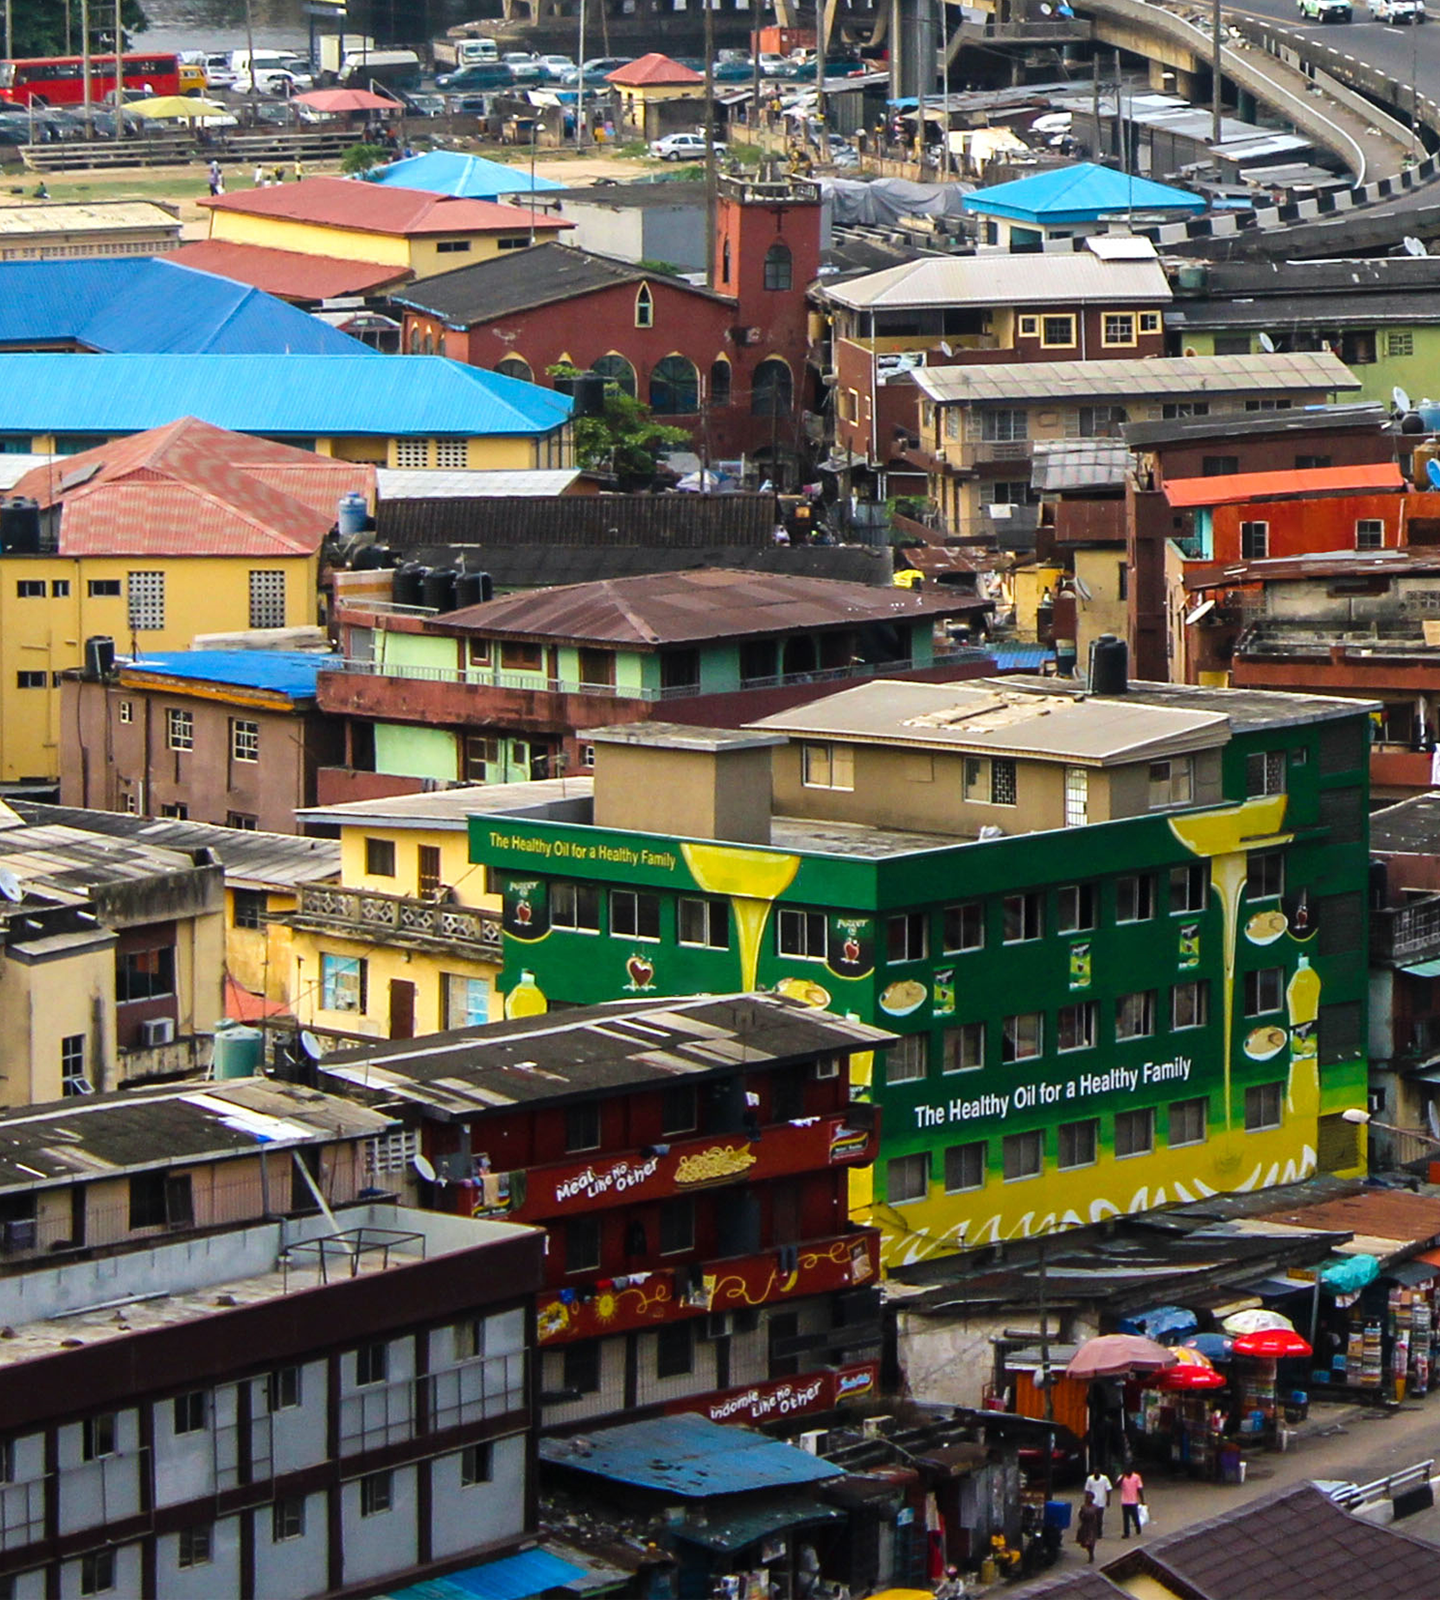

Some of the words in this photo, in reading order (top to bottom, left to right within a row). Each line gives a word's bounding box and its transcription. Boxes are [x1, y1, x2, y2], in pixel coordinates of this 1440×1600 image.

[490, 832, 510, 849] The
[511, 835, 551, 857] Healthy
[553, 841, 570, 857] Oil
[572, 844, 587, 859] for
[589, 847, 597, 859] a
[598, 845, 639, 867] Healthy
[641, 849, 676, 871] Family
[915, 1105, 945, 1127] The
[950, 1094, 1009, 1121] Healthy
[1014, 1084, 1036, 1109] Oil
[1039, 1081, 1062, 1104] for
[1066, 1082, 1076, 1098] a
[1080, 1068, 1138, 1095] Healthy
[1143, 1055, 1192, 1084] Family
[556, 1166, 595, 1201] Meal
[587, 1175, 613, 1197] Like
[616, 1156, 659, 1191] Other
[711, 1390, 760, 1419] Indomie
[752, 1398, 777, 1418] Like
[780, 1380, 822, 1414] Other
